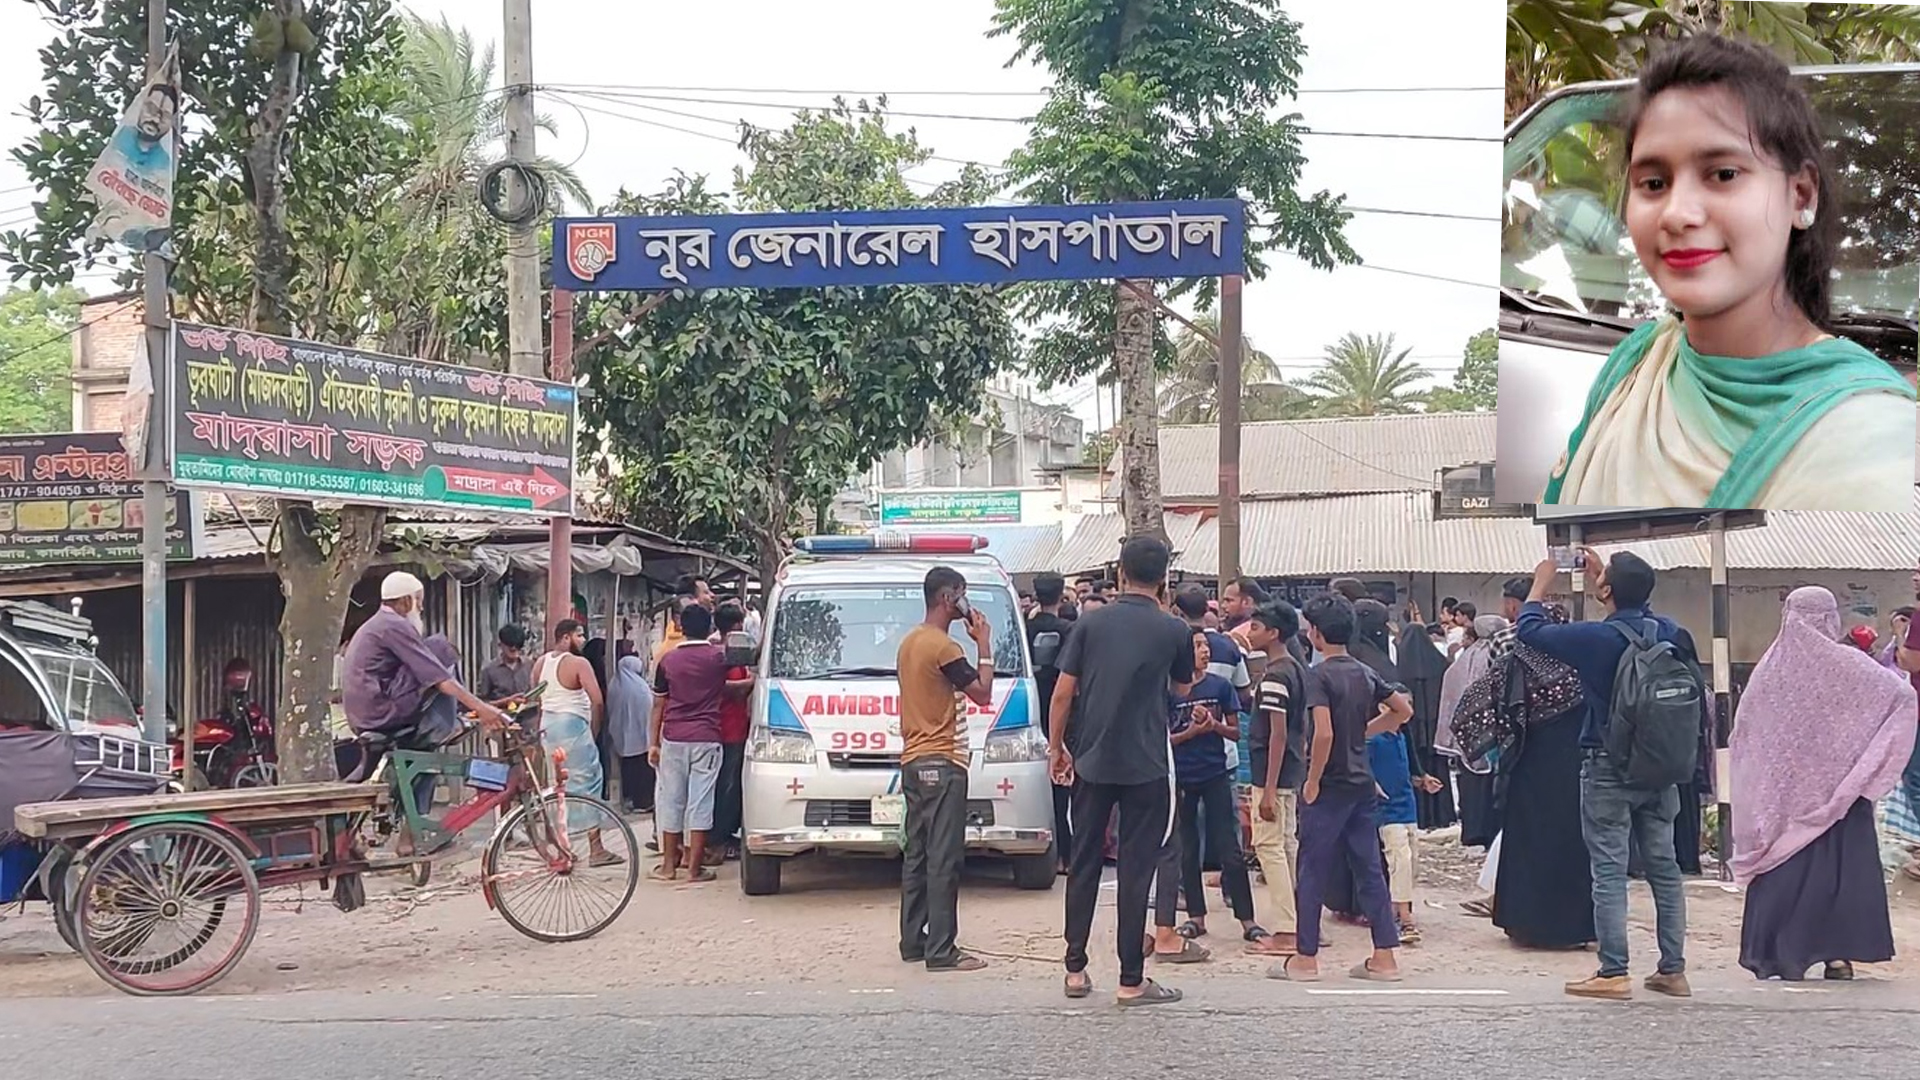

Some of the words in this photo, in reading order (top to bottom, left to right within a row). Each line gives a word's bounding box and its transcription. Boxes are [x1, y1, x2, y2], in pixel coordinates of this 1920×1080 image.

[574, 228, 611, 239] NGH
[728, 220, 945, 269] জেনারেল
[963, 209, 1229, 269] হাসপাতাল
[418, 396, 428, 423] ও
[341, 429, 428, 471] সড়ক
[501, 478, 525, 495] এই
[527, 479, 557, 497] দিকে
[1461, 497, 1490, 509] GAZI
[63, 534, 91, 543] এবং
[94, 530, 138, 542] কমিশন
[831, 732, 886, 749] 999
